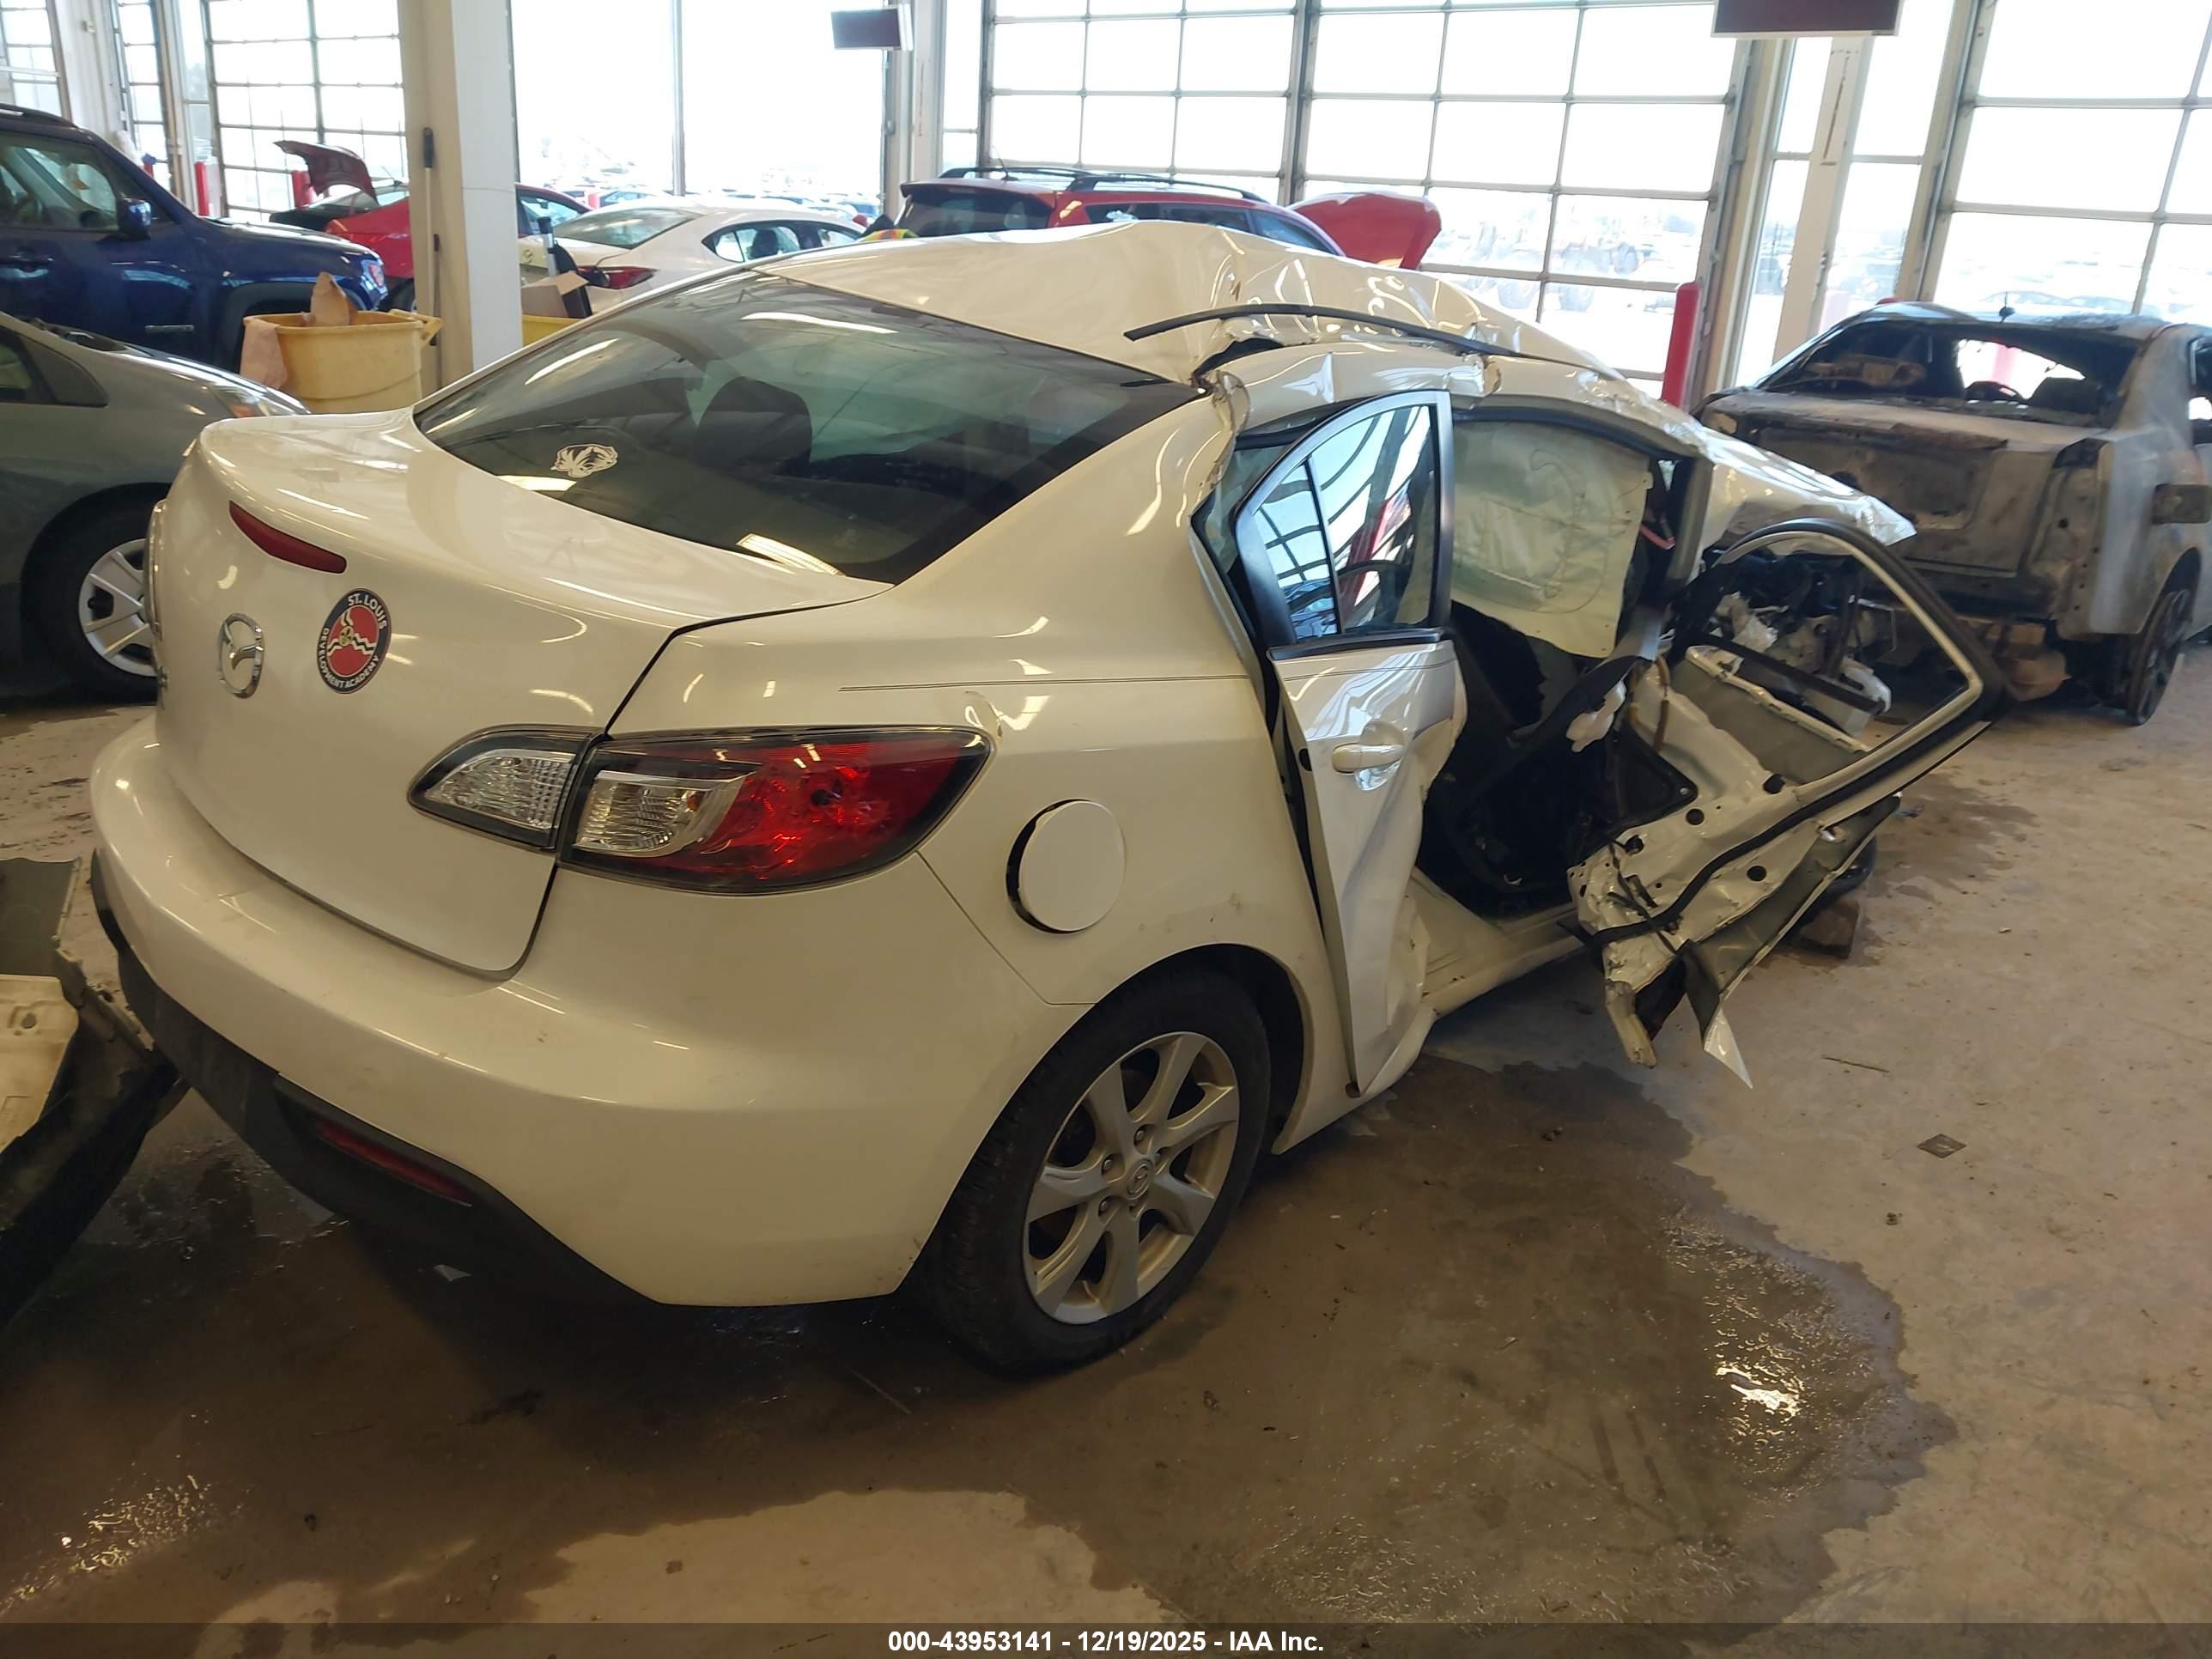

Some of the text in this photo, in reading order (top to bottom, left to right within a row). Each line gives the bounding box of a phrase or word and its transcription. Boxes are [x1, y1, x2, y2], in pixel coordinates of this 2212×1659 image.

[348, 592, 387, 629] ST. LOUIS
[318, 627, 380, 689] DEVELOPMENT ACADEMY
